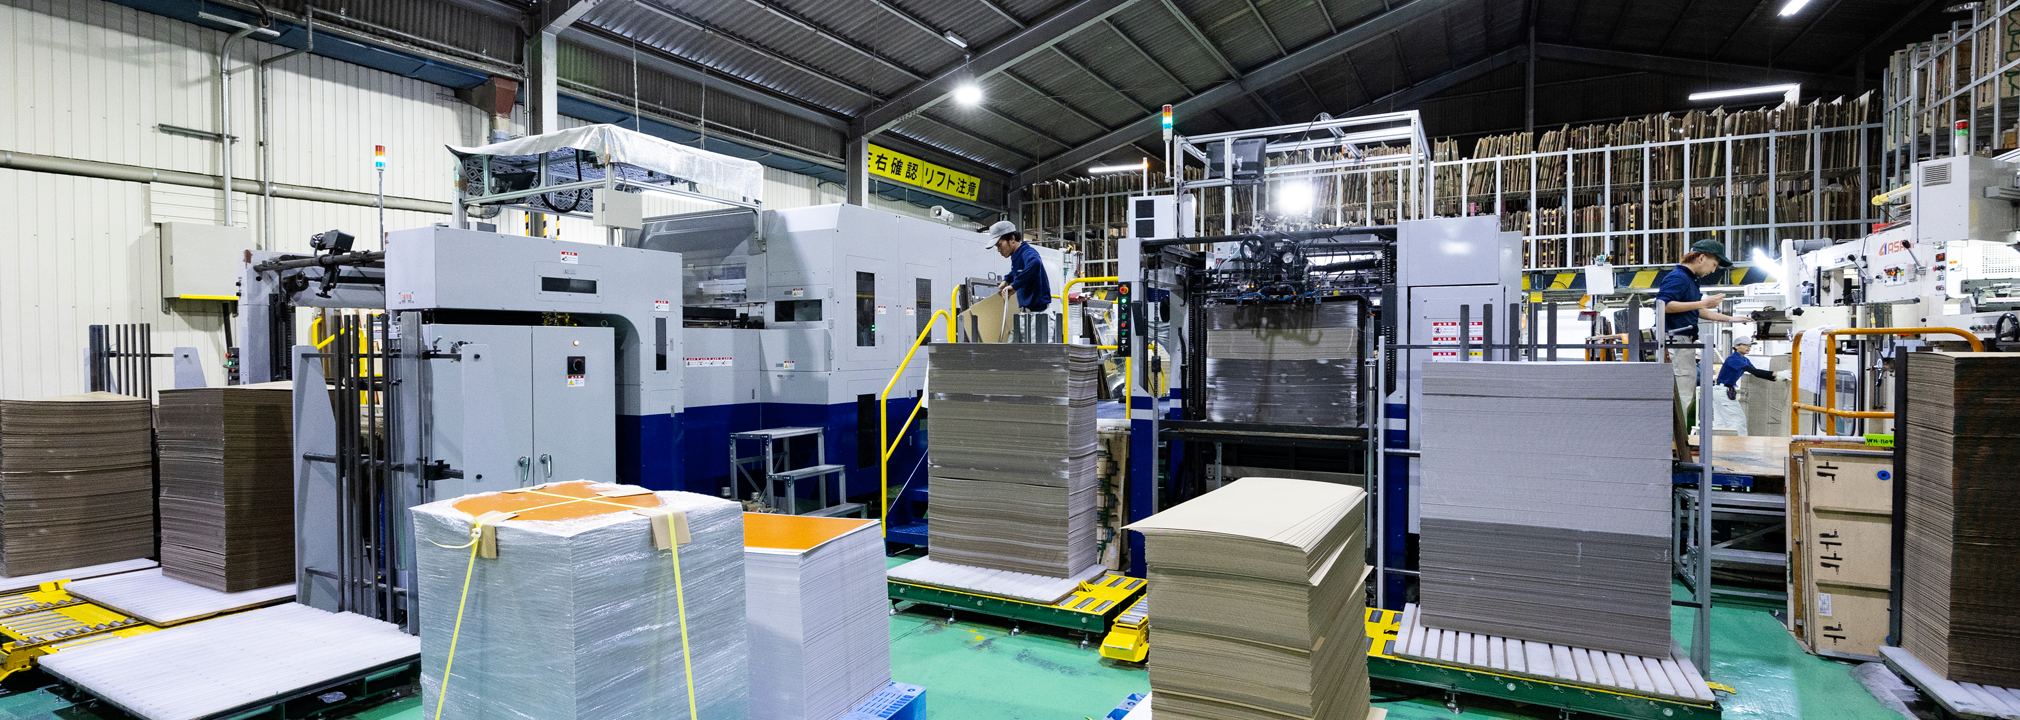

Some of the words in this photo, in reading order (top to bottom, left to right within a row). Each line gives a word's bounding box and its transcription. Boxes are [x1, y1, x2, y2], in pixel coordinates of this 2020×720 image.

[925, 167, 977, 197] リフト注意
[1888, 239, 1915, 254] ASAI
